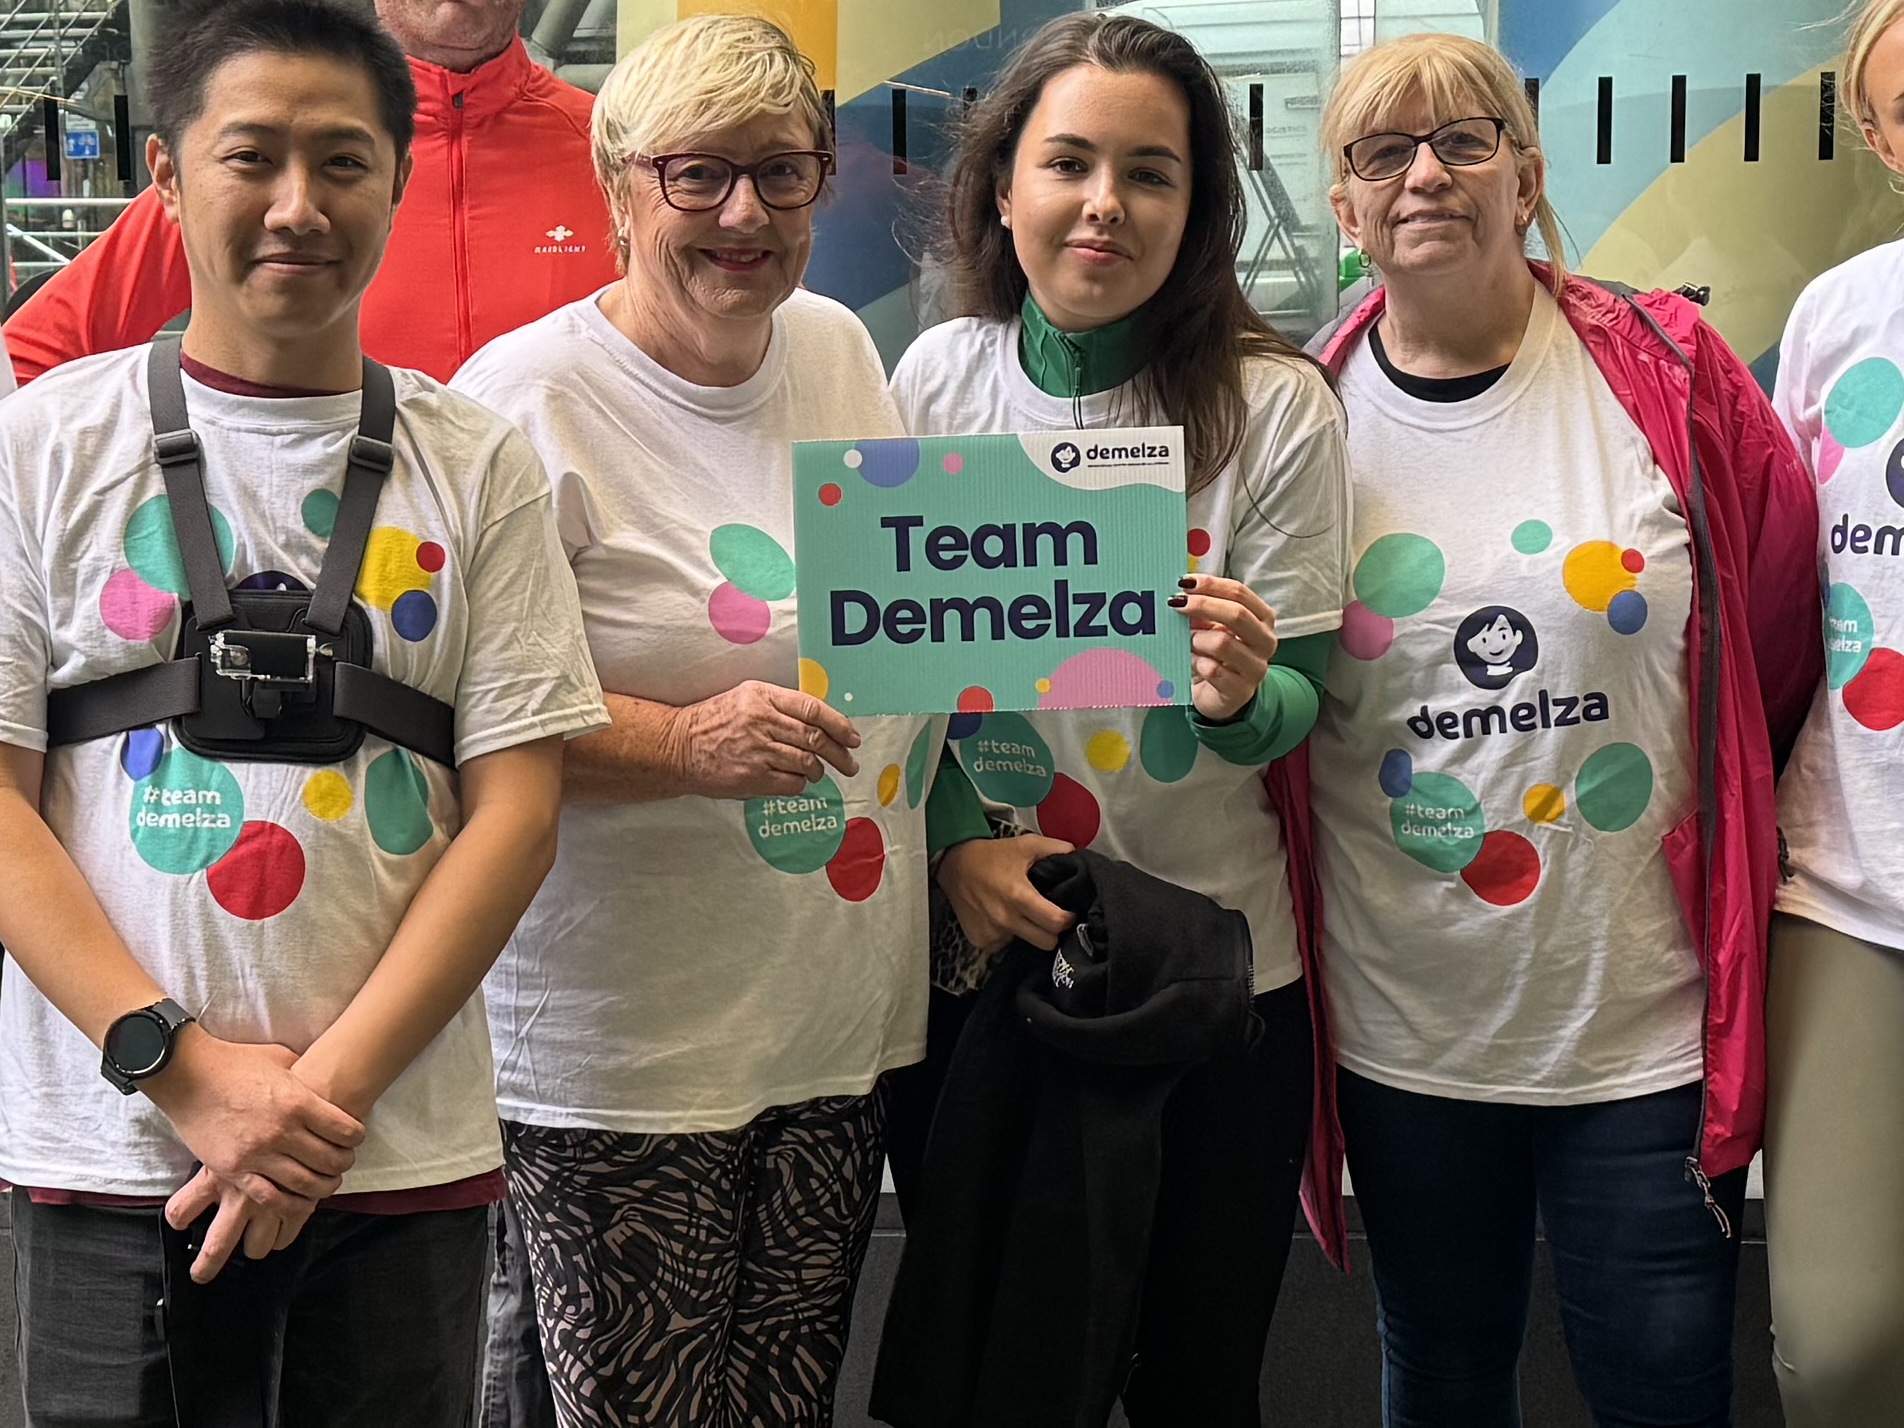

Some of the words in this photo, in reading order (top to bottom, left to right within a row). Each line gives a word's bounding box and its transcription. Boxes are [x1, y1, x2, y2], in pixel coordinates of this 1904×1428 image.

[1086, 442, 1169, 460] demelza
[880, 515, 1098, 572] Team
[830, 578, 1156, 647] Demelza
[1406, 689, 1610, 740] demelza
[977, 739, 1035, 758] #team
[973, 756, 1047, 778] demelza
[143, 785, 221, 806] #team
[136, 805, 232, 828] demelza
[762, 797, 828, 817] #team
[1405, 803, 1465, 821] #team
[757, 814, 838, 838] demelza
[1401, 820, 1475, 839] demelza
